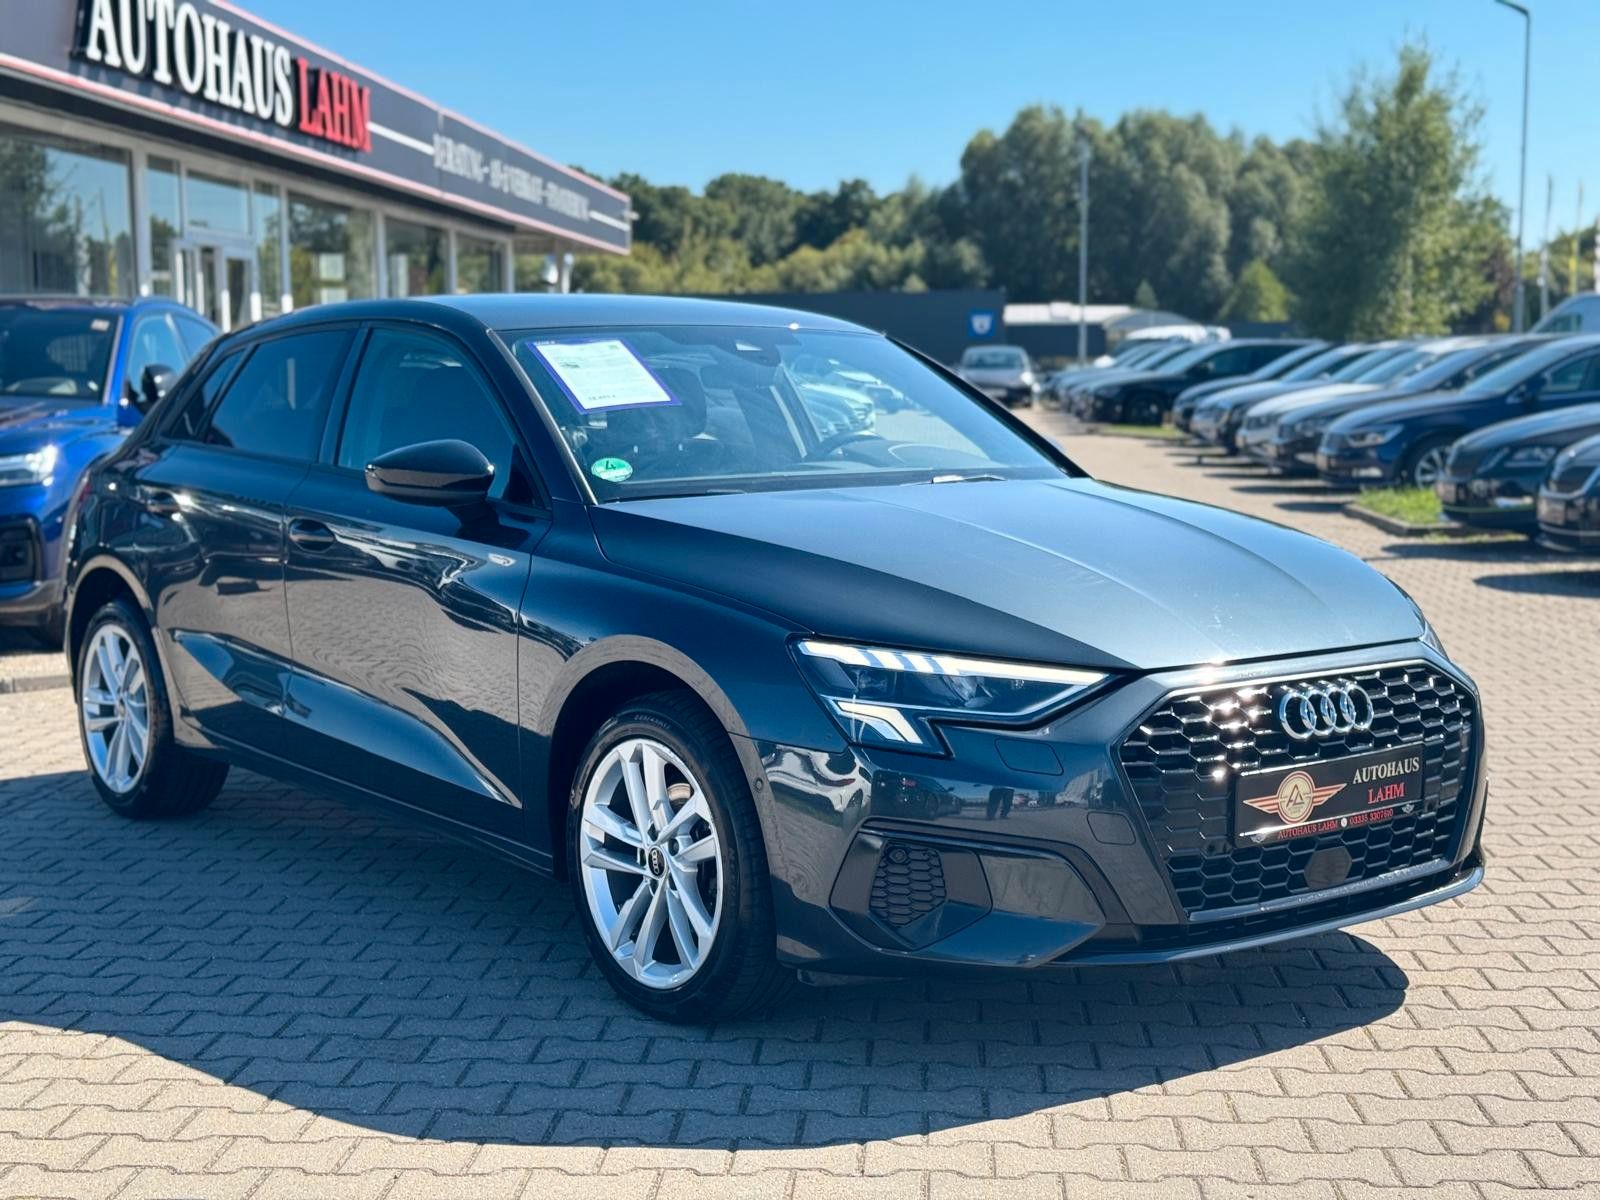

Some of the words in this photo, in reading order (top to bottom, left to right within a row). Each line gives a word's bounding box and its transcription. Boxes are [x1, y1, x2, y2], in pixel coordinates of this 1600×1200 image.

[87, 0, 295, 127] AUTOHAUS
[296, 57, 372, 153] LAHM
[605, 460, 617, 471] 4
[1353, 756, 1420, 784] AUTOHAUS
[1368, 782, 1405, 804] LAHM
[1278, 825, 1317, 840] AUTOHAUS
[1318, 820, 1338, 833] LAHM
